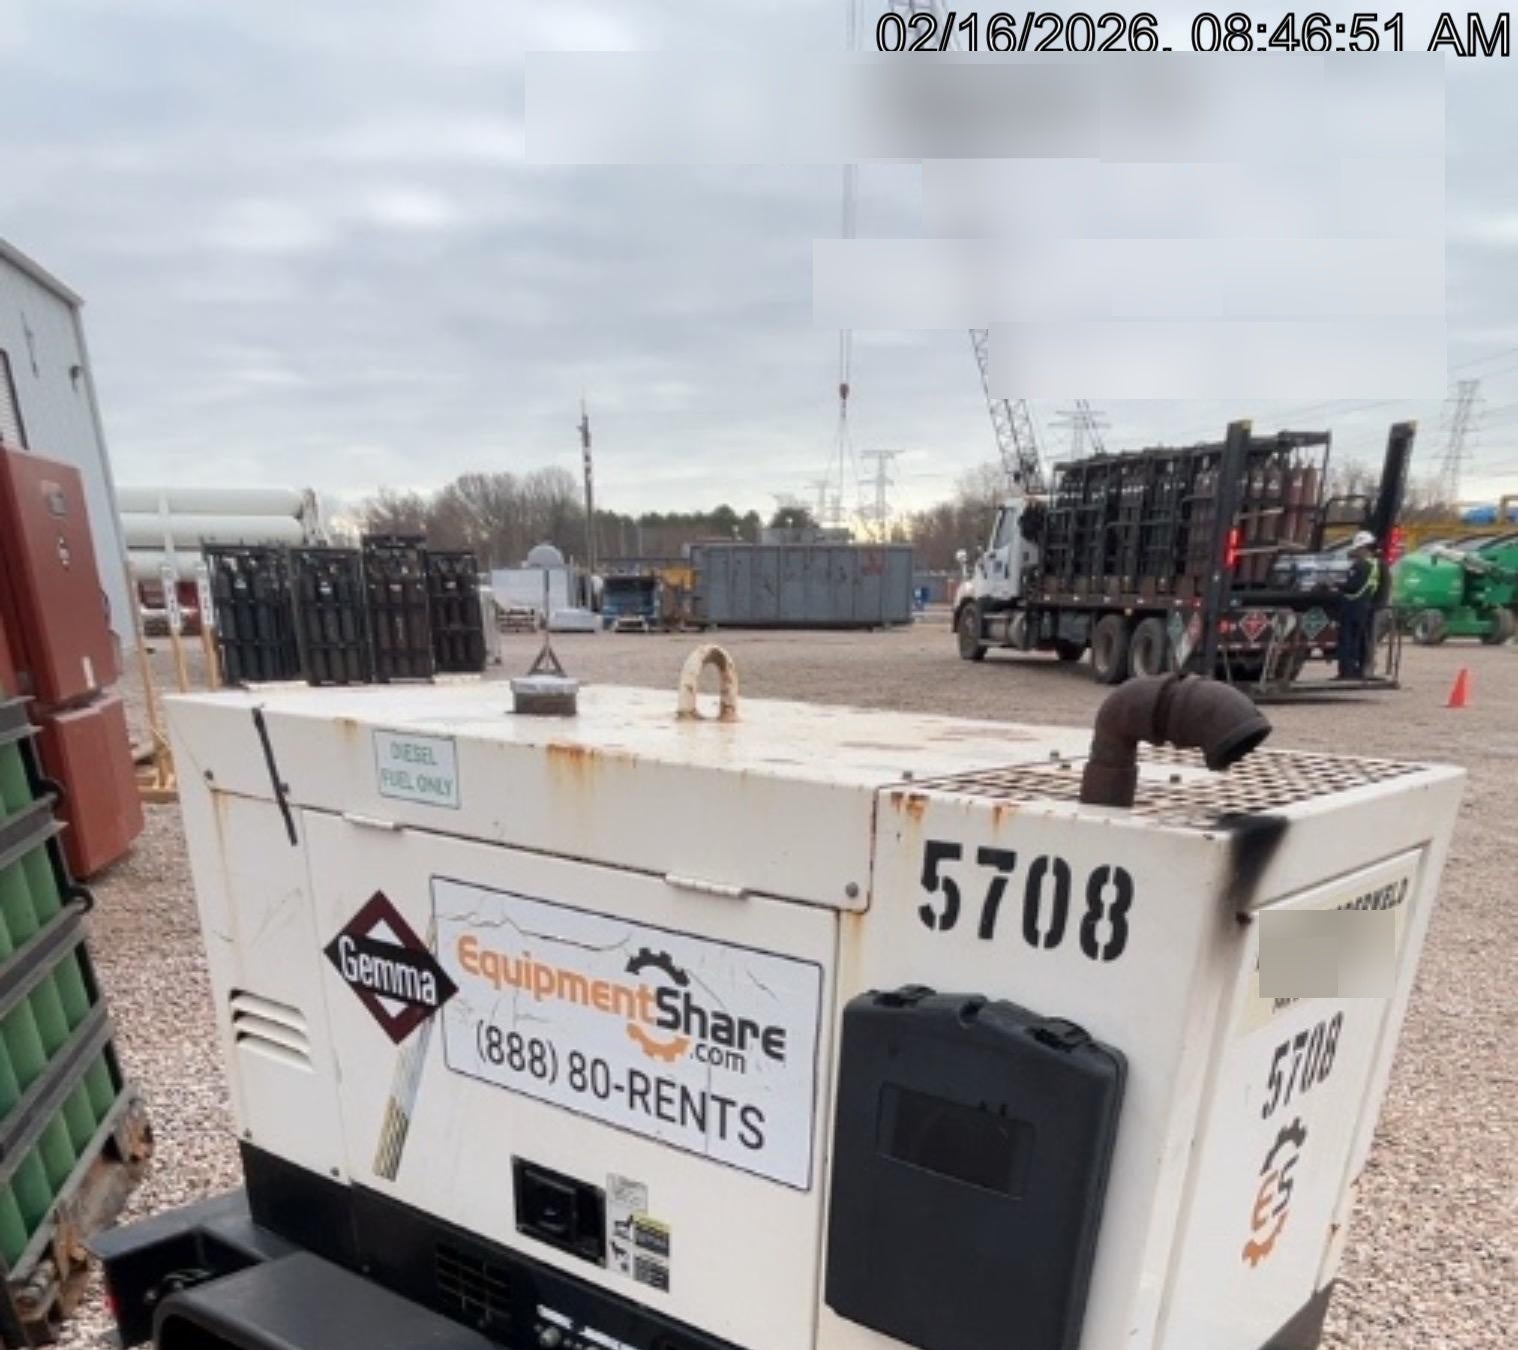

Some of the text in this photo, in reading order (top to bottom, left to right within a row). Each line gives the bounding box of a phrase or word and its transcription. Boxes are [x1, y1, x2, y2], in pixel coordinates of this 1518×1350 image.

[380, 767, 453, 800] FUEL ONLY
[390, 741, 438, 765] DIESEL
[918, 839, 1134, 963] 5708
[338, 934, 437, 1007] Gemma
[456, 935, 787, 1062] EquipmentShare
[475, 1019, 766, 1152] (888) 80-RENTS
[690, 1041, 747, 1075] .com
[1261, 1011, 1343, 1119] 5708
